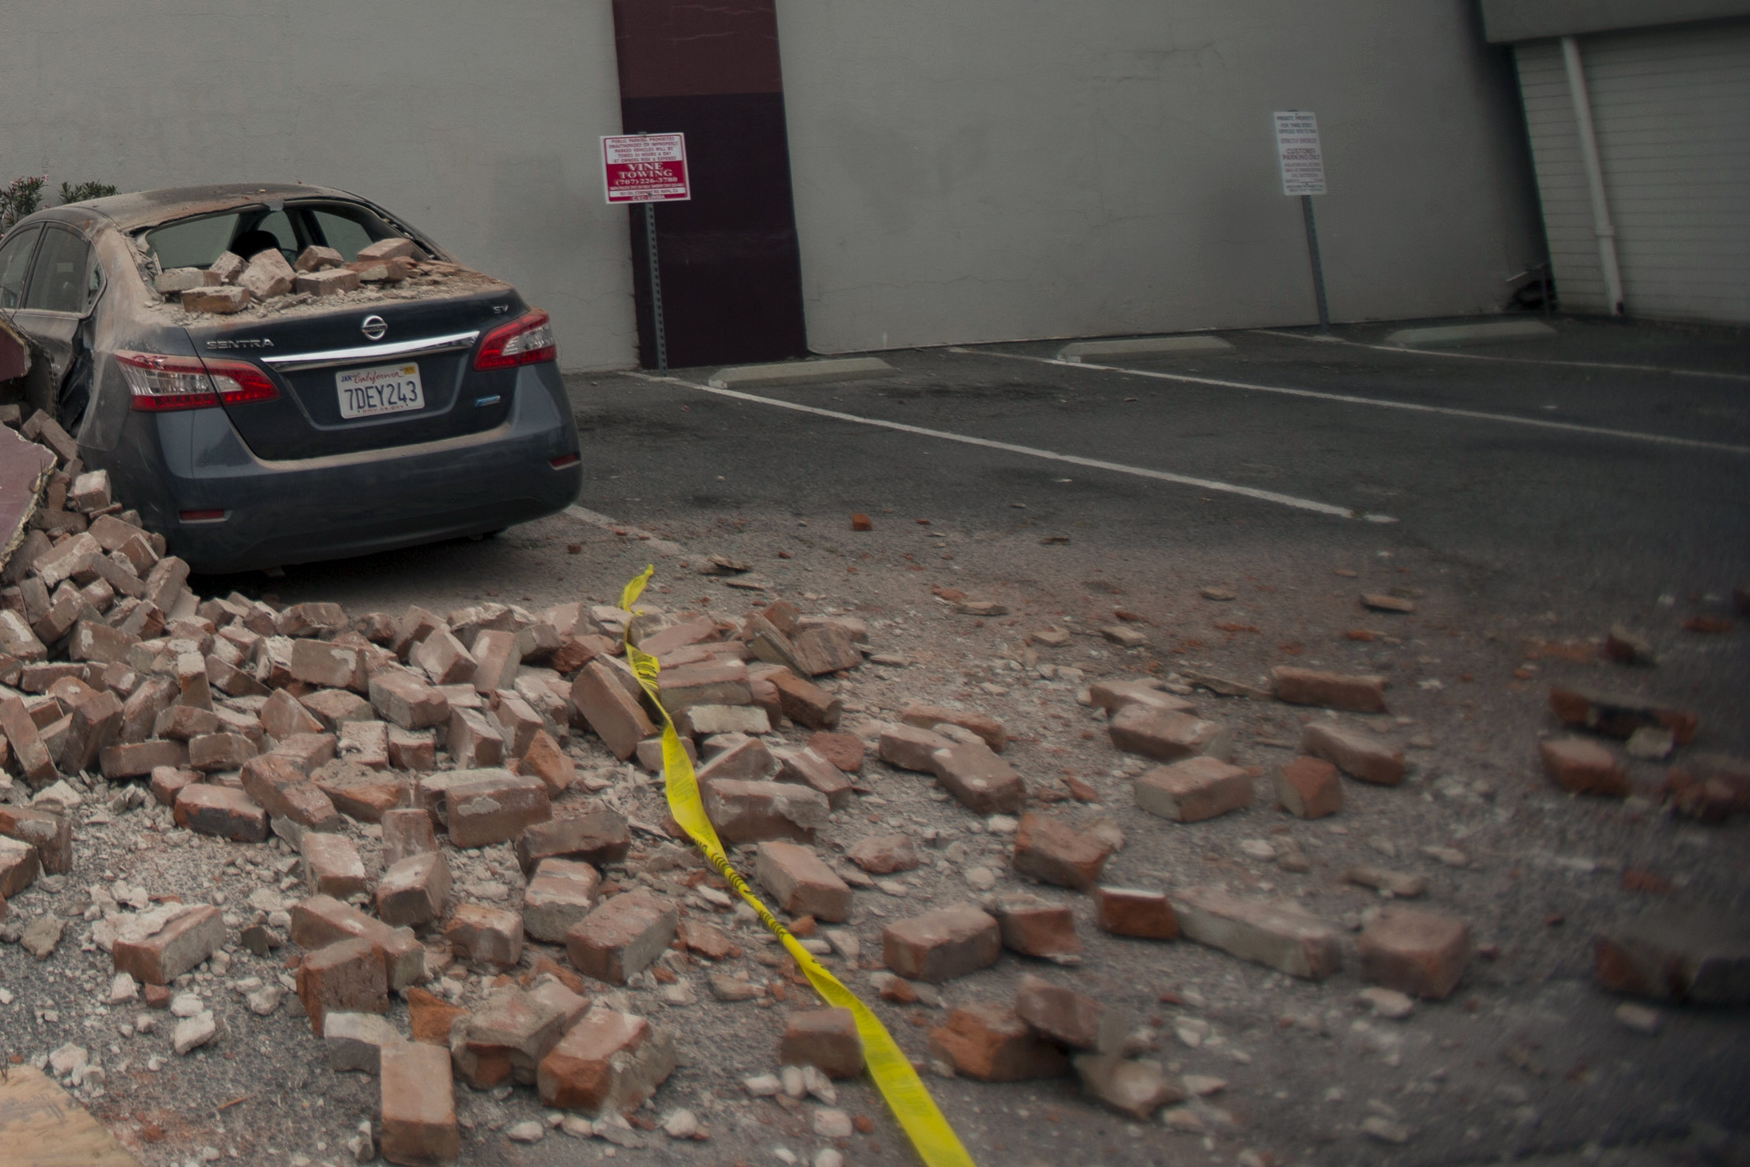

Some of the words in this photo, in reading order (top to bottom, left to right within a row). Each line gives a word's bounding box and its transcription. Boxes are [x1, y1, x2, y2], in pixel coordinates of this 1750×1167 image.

[628, 163, 664, 171] VINE
[618, 170, 673, 178] TOWING
[493, 305, 509, 313] SV
[207, 338, 274, 349] SENTRA
[354, 370, 404, 384] California
[344, 380, 418, 410] 7DEY243
